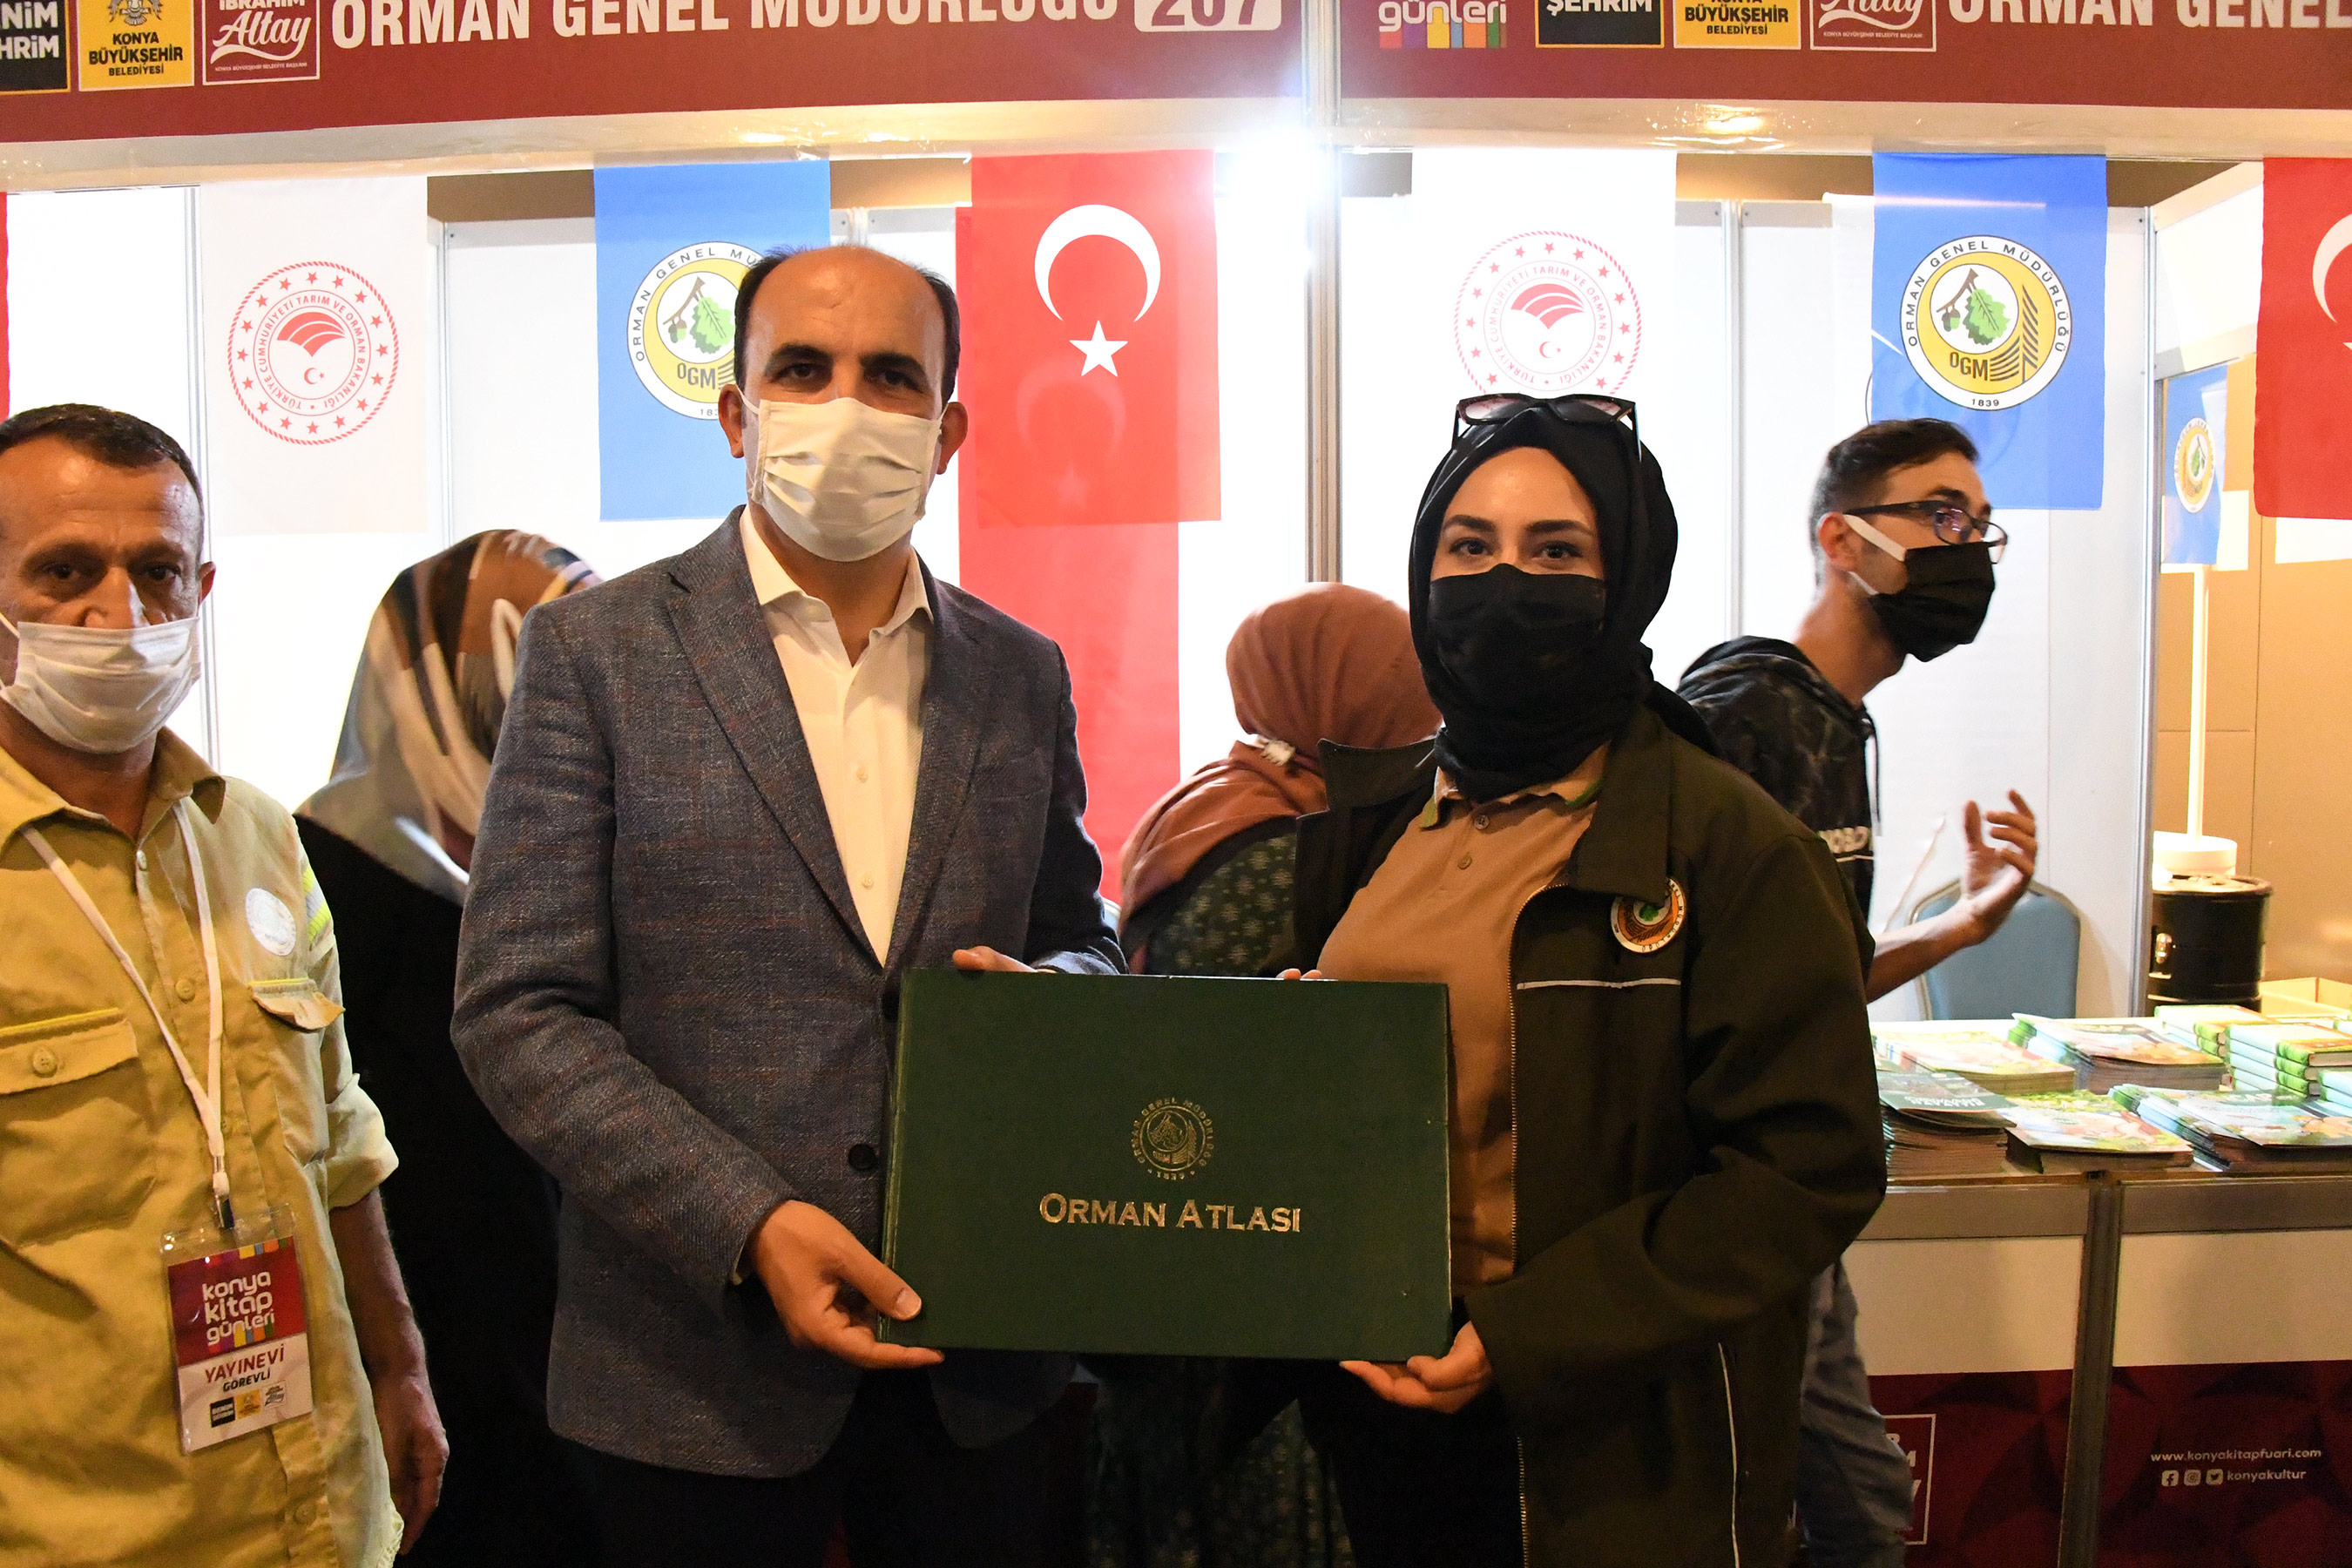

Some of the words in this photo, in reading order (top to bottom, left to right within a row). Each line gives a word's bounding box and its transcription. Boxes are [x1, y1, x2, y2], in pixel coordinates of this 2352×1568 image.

[332, 0, 530, 49] ORMAN
[553, 0, 729, 37] GENEL
[1378, 0, 1507, 32] günleri
[1685, 4, 1788, 24] BÜYÜKŞEHİR
[112, 31, 159, 45] KONYA
[210, 10, 312, 64] Altay
[1707, 24, 1767, 35] BELEDİYESİ
[89, 44, 183, 64] BÜYÜKŞEHİR
[108, 64, 164, 77] BELEDİYESİ
[296, 294, 330, 306] TARIM
[333, 301, 346, 314] VE
[633, 289, 651, 362] ORMAN
[656, 247, 715, 279] GENEL
[1533, 266, 1569, 277] TARIM
[1573, 274, 1586, 287] VE
[1586, 287, 1607, 329] ORMAN
[1906, 276, 1925, 346] ORMAN
[1930, 240, 1989, 267] GENEL
[2004, 244, 2069, 352] MÜDÜRLÜĞÜ
[258, 299, 294, 373] CUMHURİYETİ
[346, 313, 366, 354] ORMAN
[677, 362, 716, 390] OGM
[1950, 352, 1988, 381] OGM
[263, 375, 302, 409] TÜRKİYE
[323, 357, 365, 409] BAKANLIĞI
[1971, 398, 1999, 407] 1839
[202, 1272, 271, 1301] konya
[205, 1291, 273, 1324] kitap
[206, 1308, 275, 1346] günleri
[205, 1343, 284, 1383] YAYINEVİ
[2150, 1448, 2322, 1463] www.konyakitapfuari.com
[2227, 1469, 2307, 1483] konyakultur
